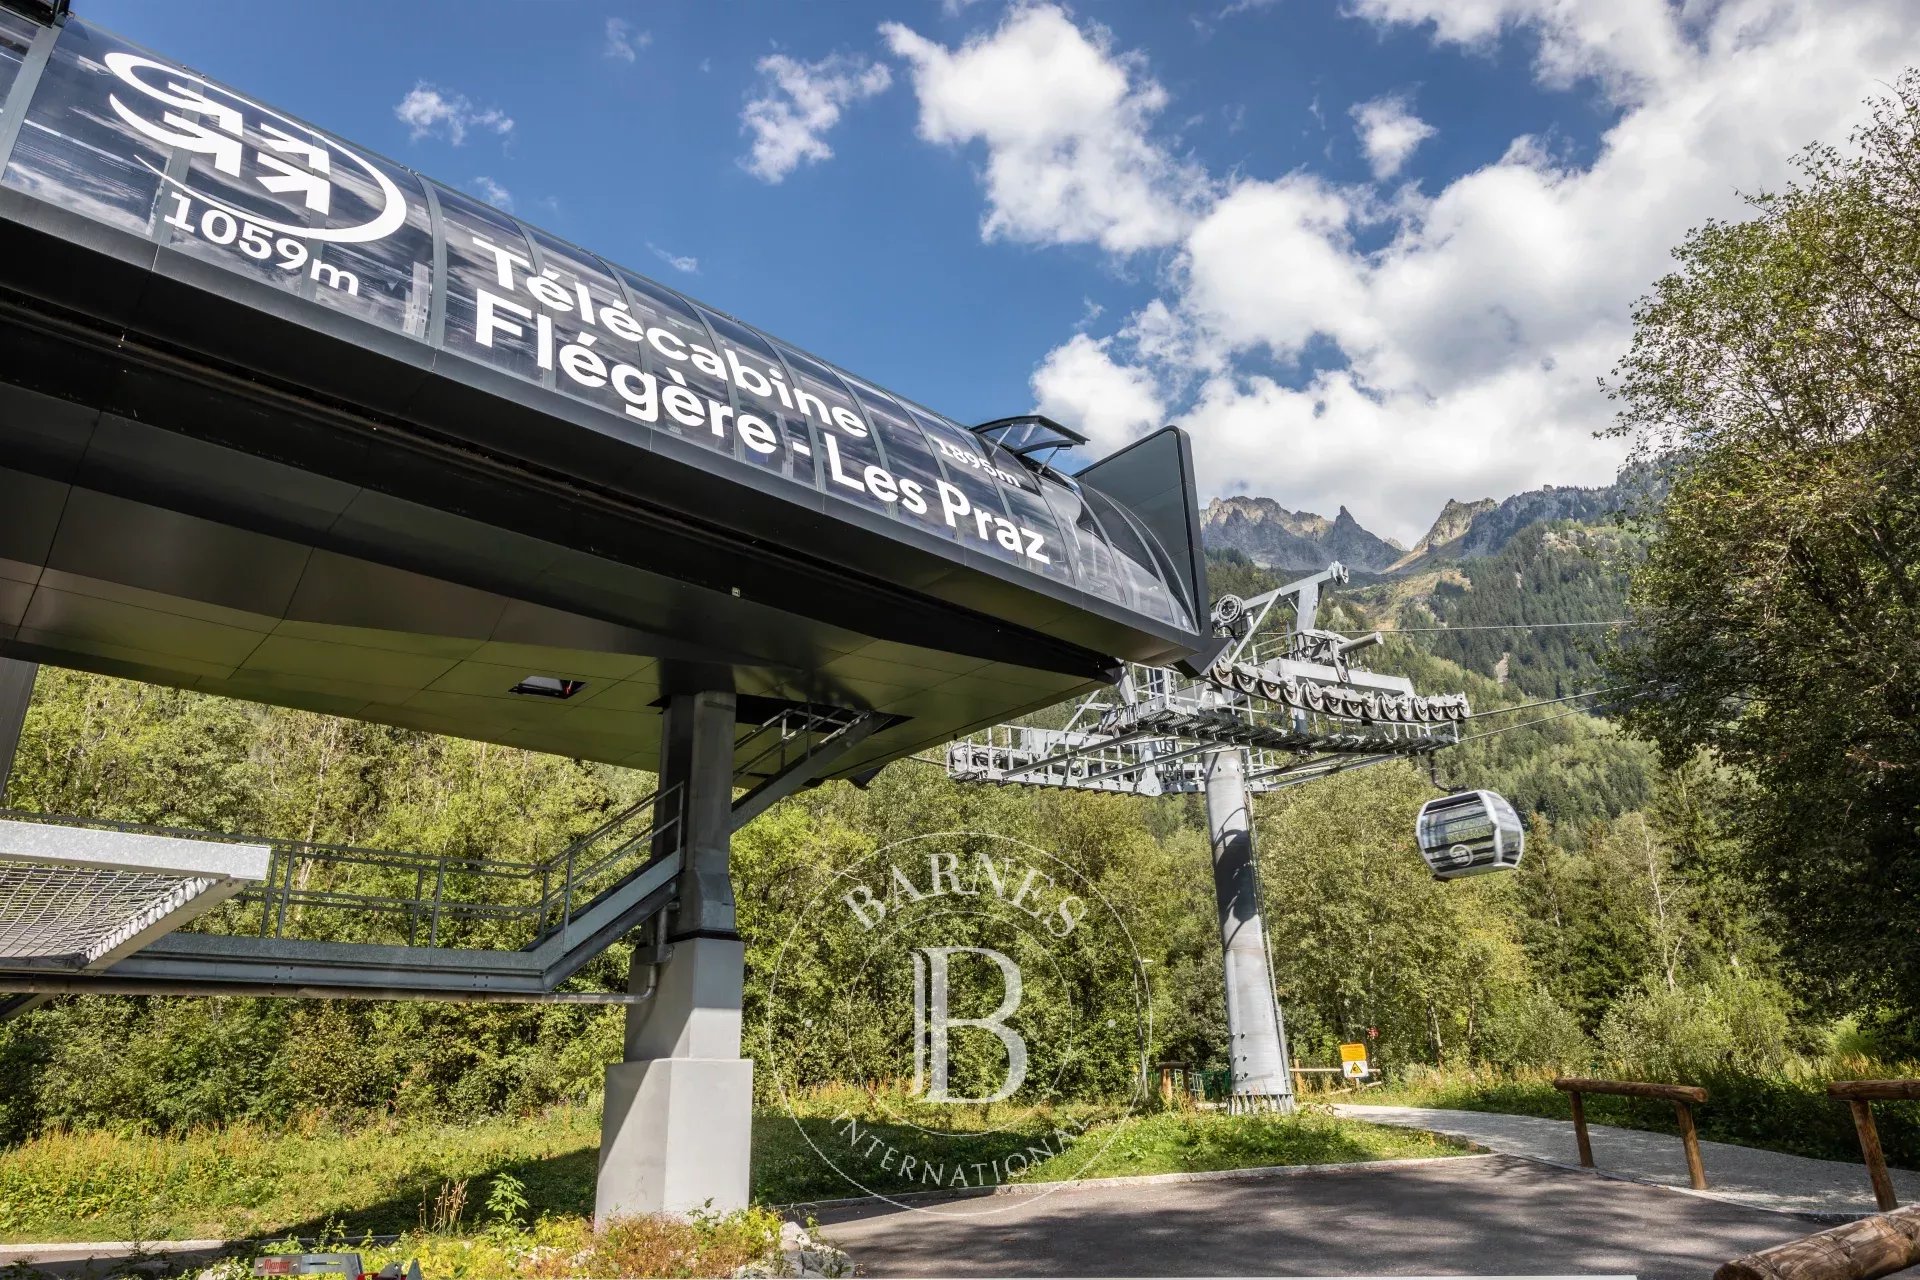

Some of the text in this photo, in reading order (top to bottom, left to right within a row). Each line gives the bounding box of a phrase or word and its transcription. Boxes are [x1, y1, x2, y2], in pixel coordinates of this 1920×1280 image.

[164, 190, 359, 298] 1059m
[473, 236, 868, 438] Télécabine
[824, 432, 928, 515] Les
[935, 478, 1051, 565] Praz
[927, 432, 1021, 488] 1895m
